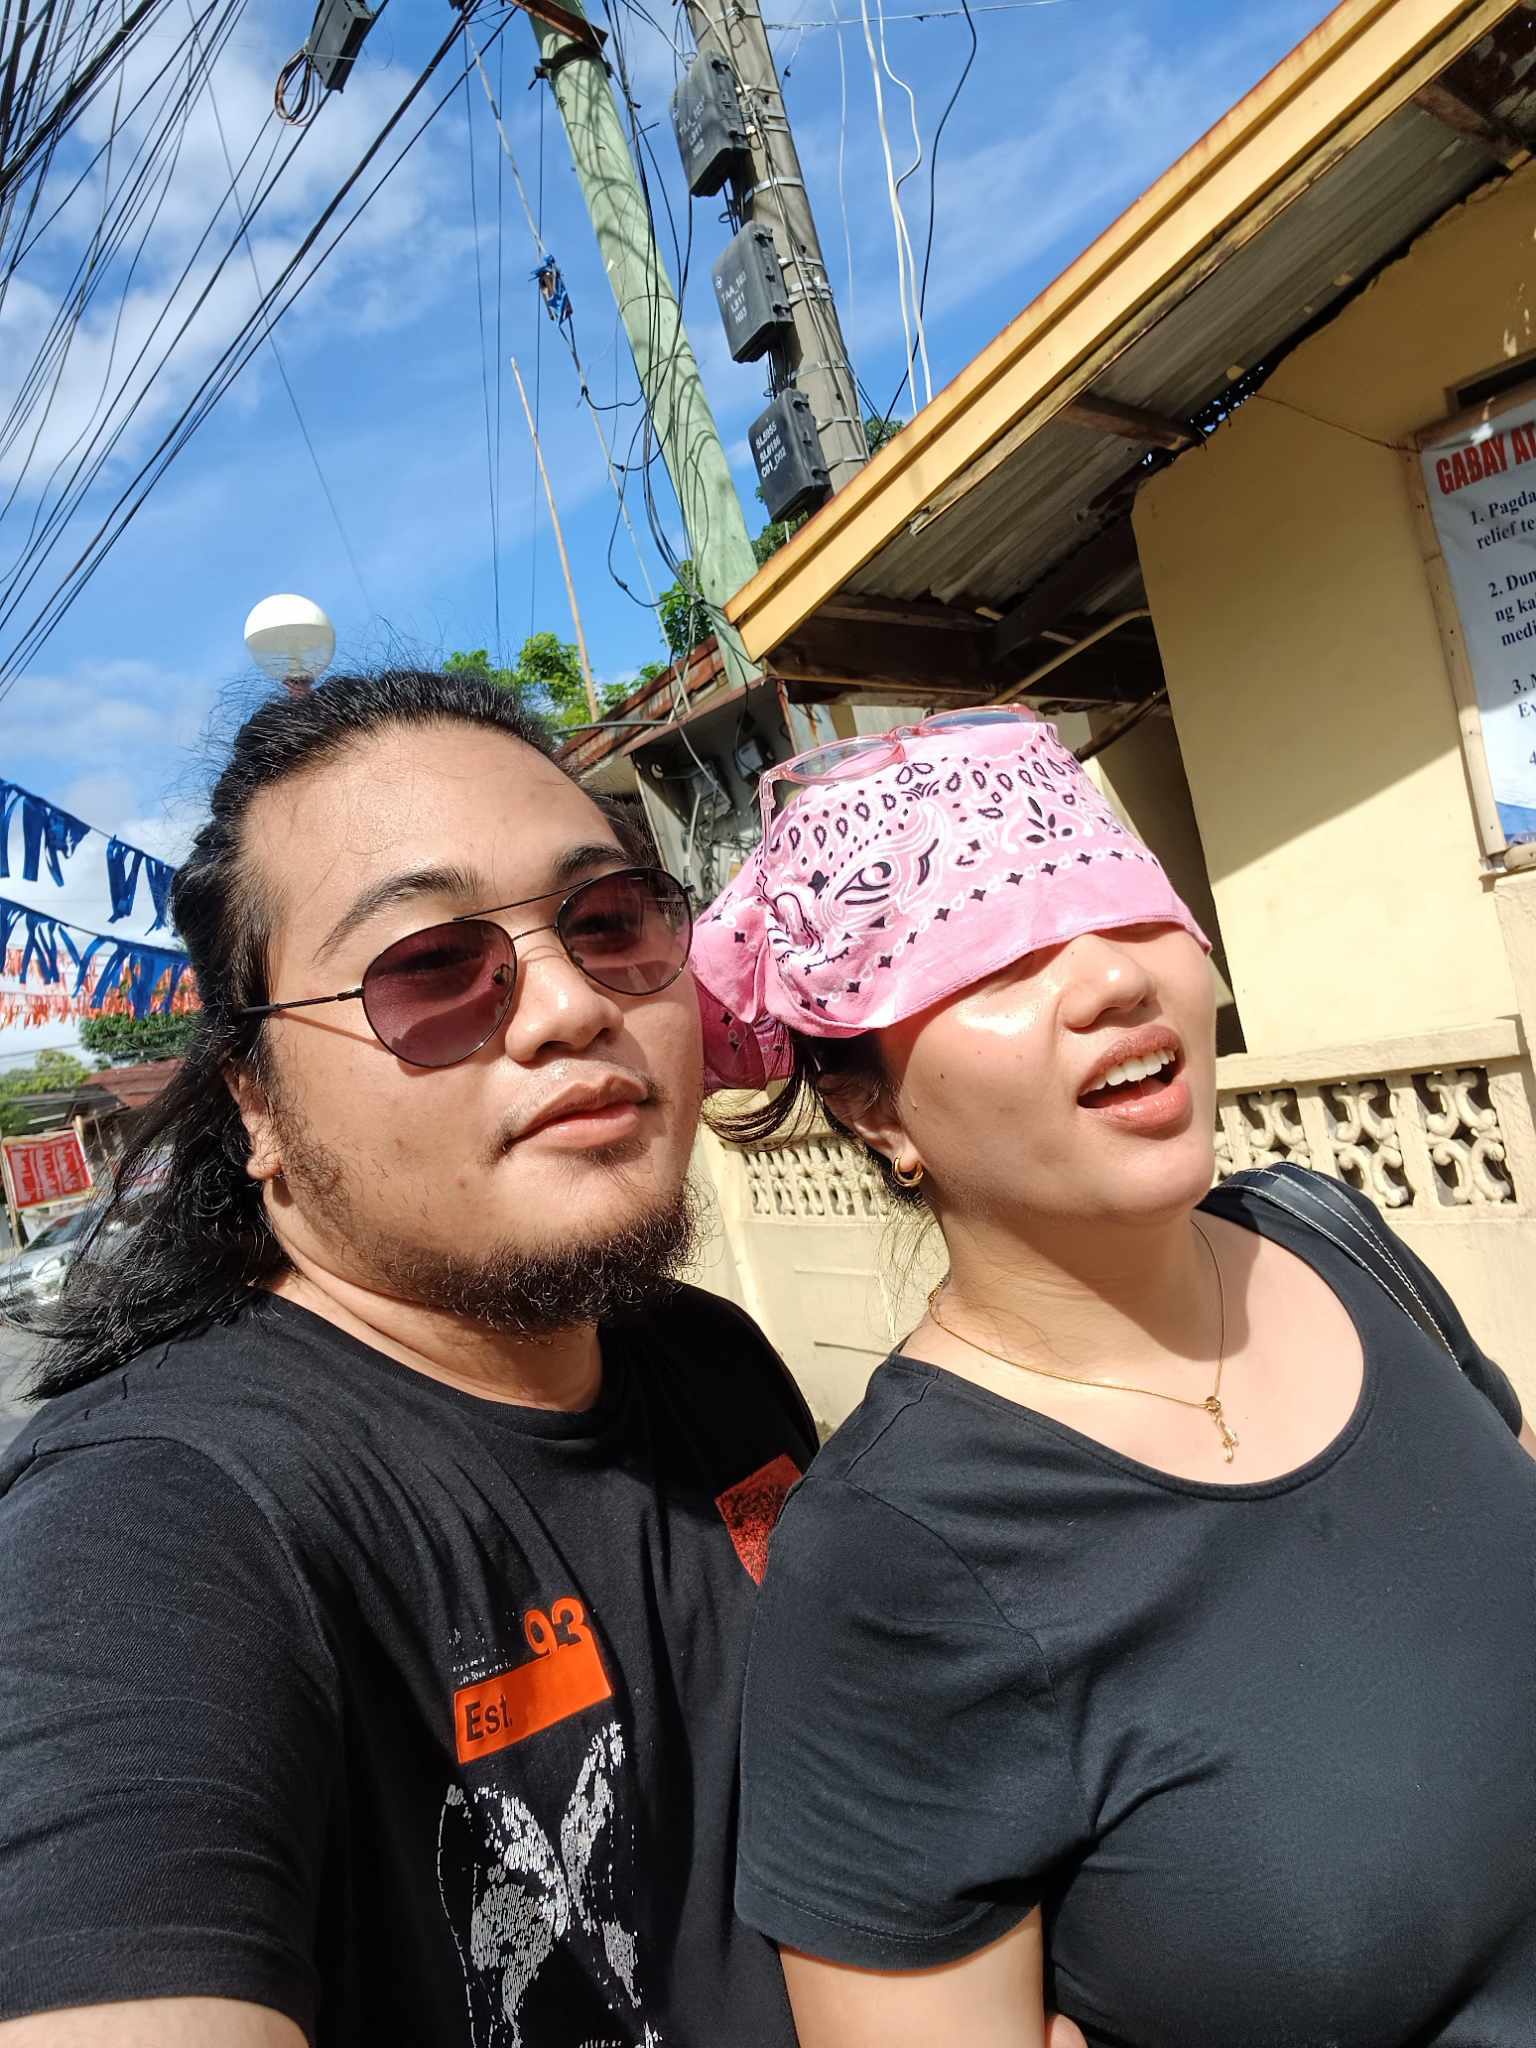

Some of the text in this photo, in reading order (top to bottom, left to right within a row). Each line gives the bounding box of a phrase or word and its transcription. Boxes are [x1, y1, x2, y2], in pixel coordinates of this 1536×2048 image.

[1436, 431, 1508, 495] GABAY
[1470, 510, 1485, 525] 1.
[1477, 520, 1516, 549] relief
[1488, 582, 1503, 597] 2.
[1495, 607, 1515, 622] ng
[1512, 678, 1528, 695] 3.
